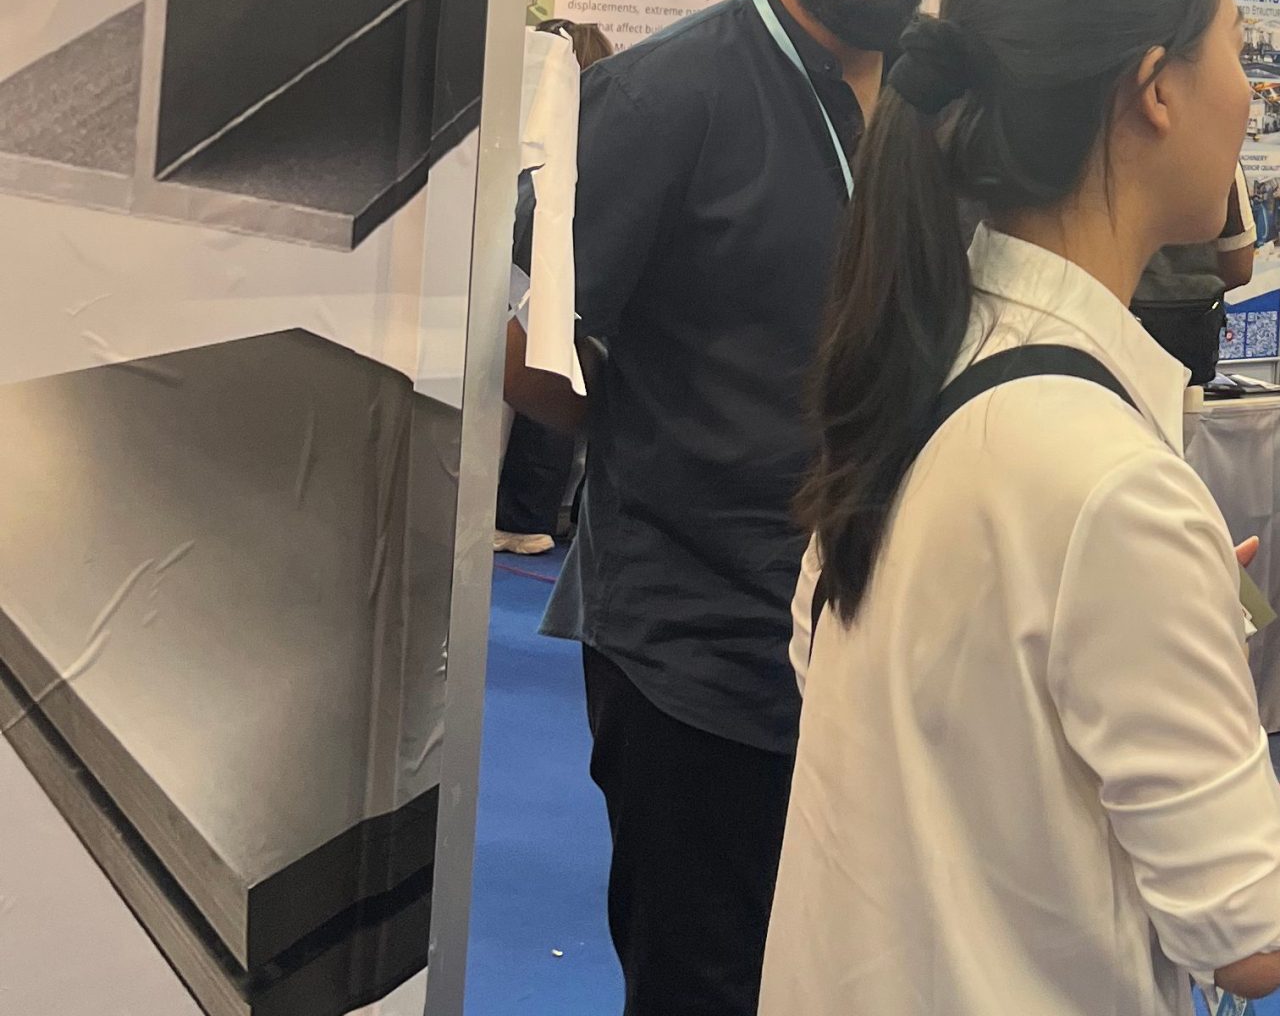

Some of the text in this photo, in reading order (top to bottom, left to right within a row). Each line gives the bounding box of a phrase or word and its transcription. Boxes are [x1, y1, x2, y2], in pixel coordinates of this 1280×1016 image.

[567, 0, 639, 13] displacements,
[645, 5, 683, 16] extreme
[616, 22, 642, 33] affect
